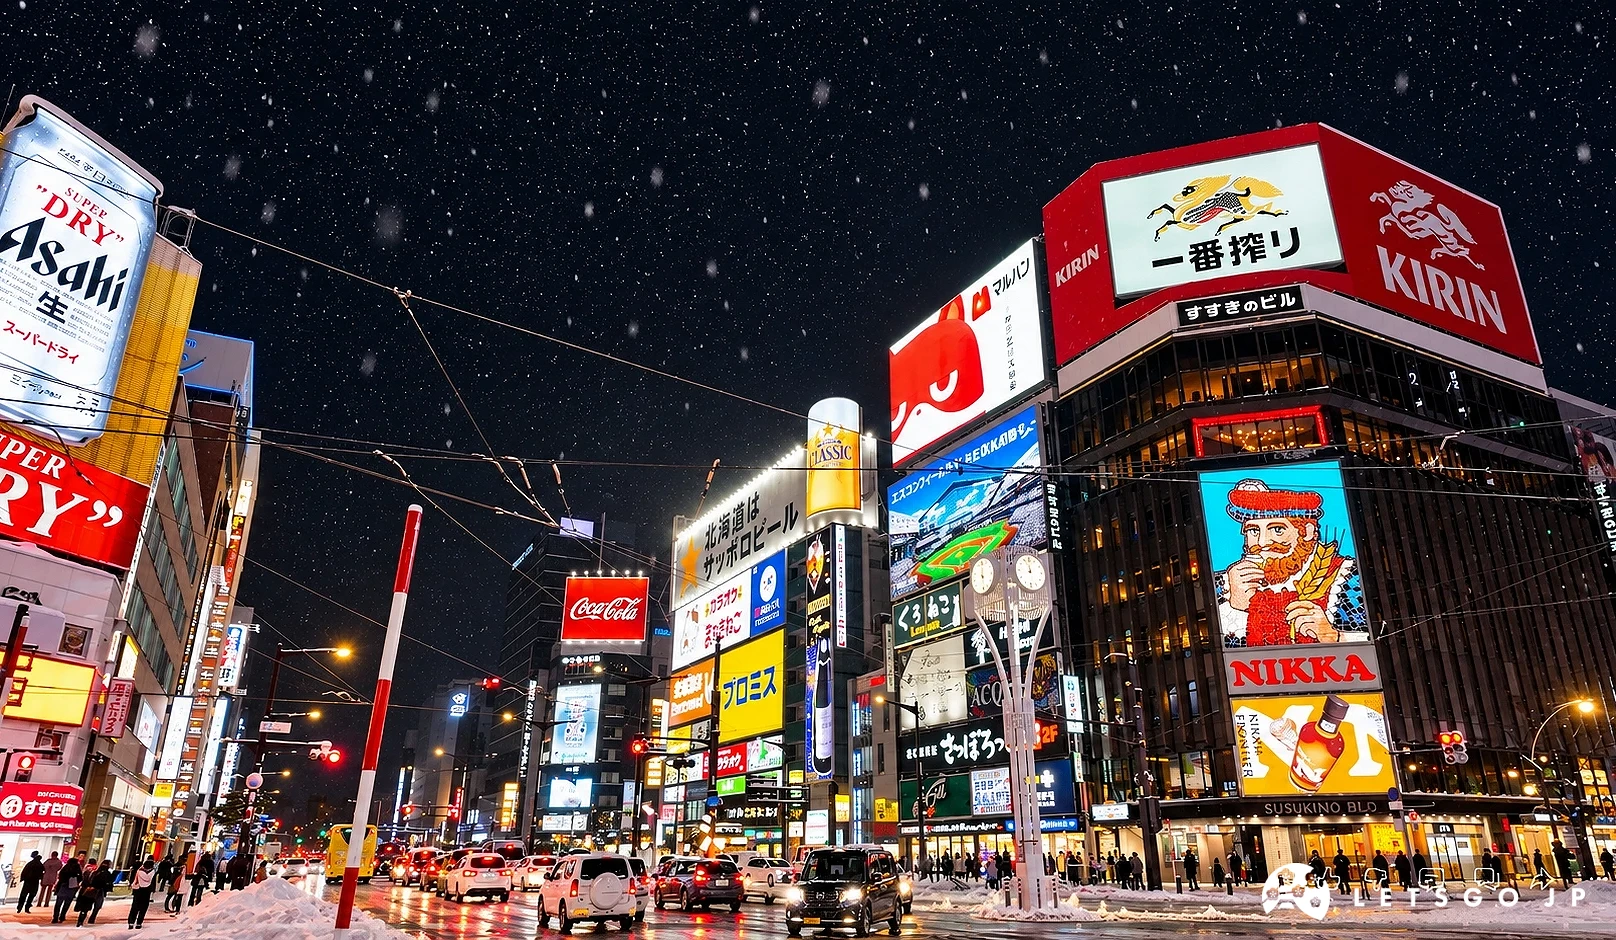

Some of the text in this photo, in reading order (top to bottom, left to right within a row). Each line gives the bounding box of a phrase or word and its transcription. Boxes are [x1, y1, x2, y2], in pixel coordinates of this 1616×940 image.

[0, 216, 129, 312] Asahi
[1054, 244, 1100, 288] KIRIN
[1152, 226, 1301, 273] 一番搾り
[992, 257, 1030, 296] マルハン
[1376, 244, 1508, 335] KIRIN
[36, 291, 69, 325] 生
[1185, 292, 1296, 320] すすきのビル
[3, 320, 80, 365] スーパードライ
[0, 433, 67, 480] PER
[703, 501, 799, 582] サッポロビール
[704, 491, 760, 552] 北海道は
[723, 666, 777, 710] プロミス
[1230, 654, 1377, 687] NIKKA
[1265, 802, 1340, 814] SUSUKINO
